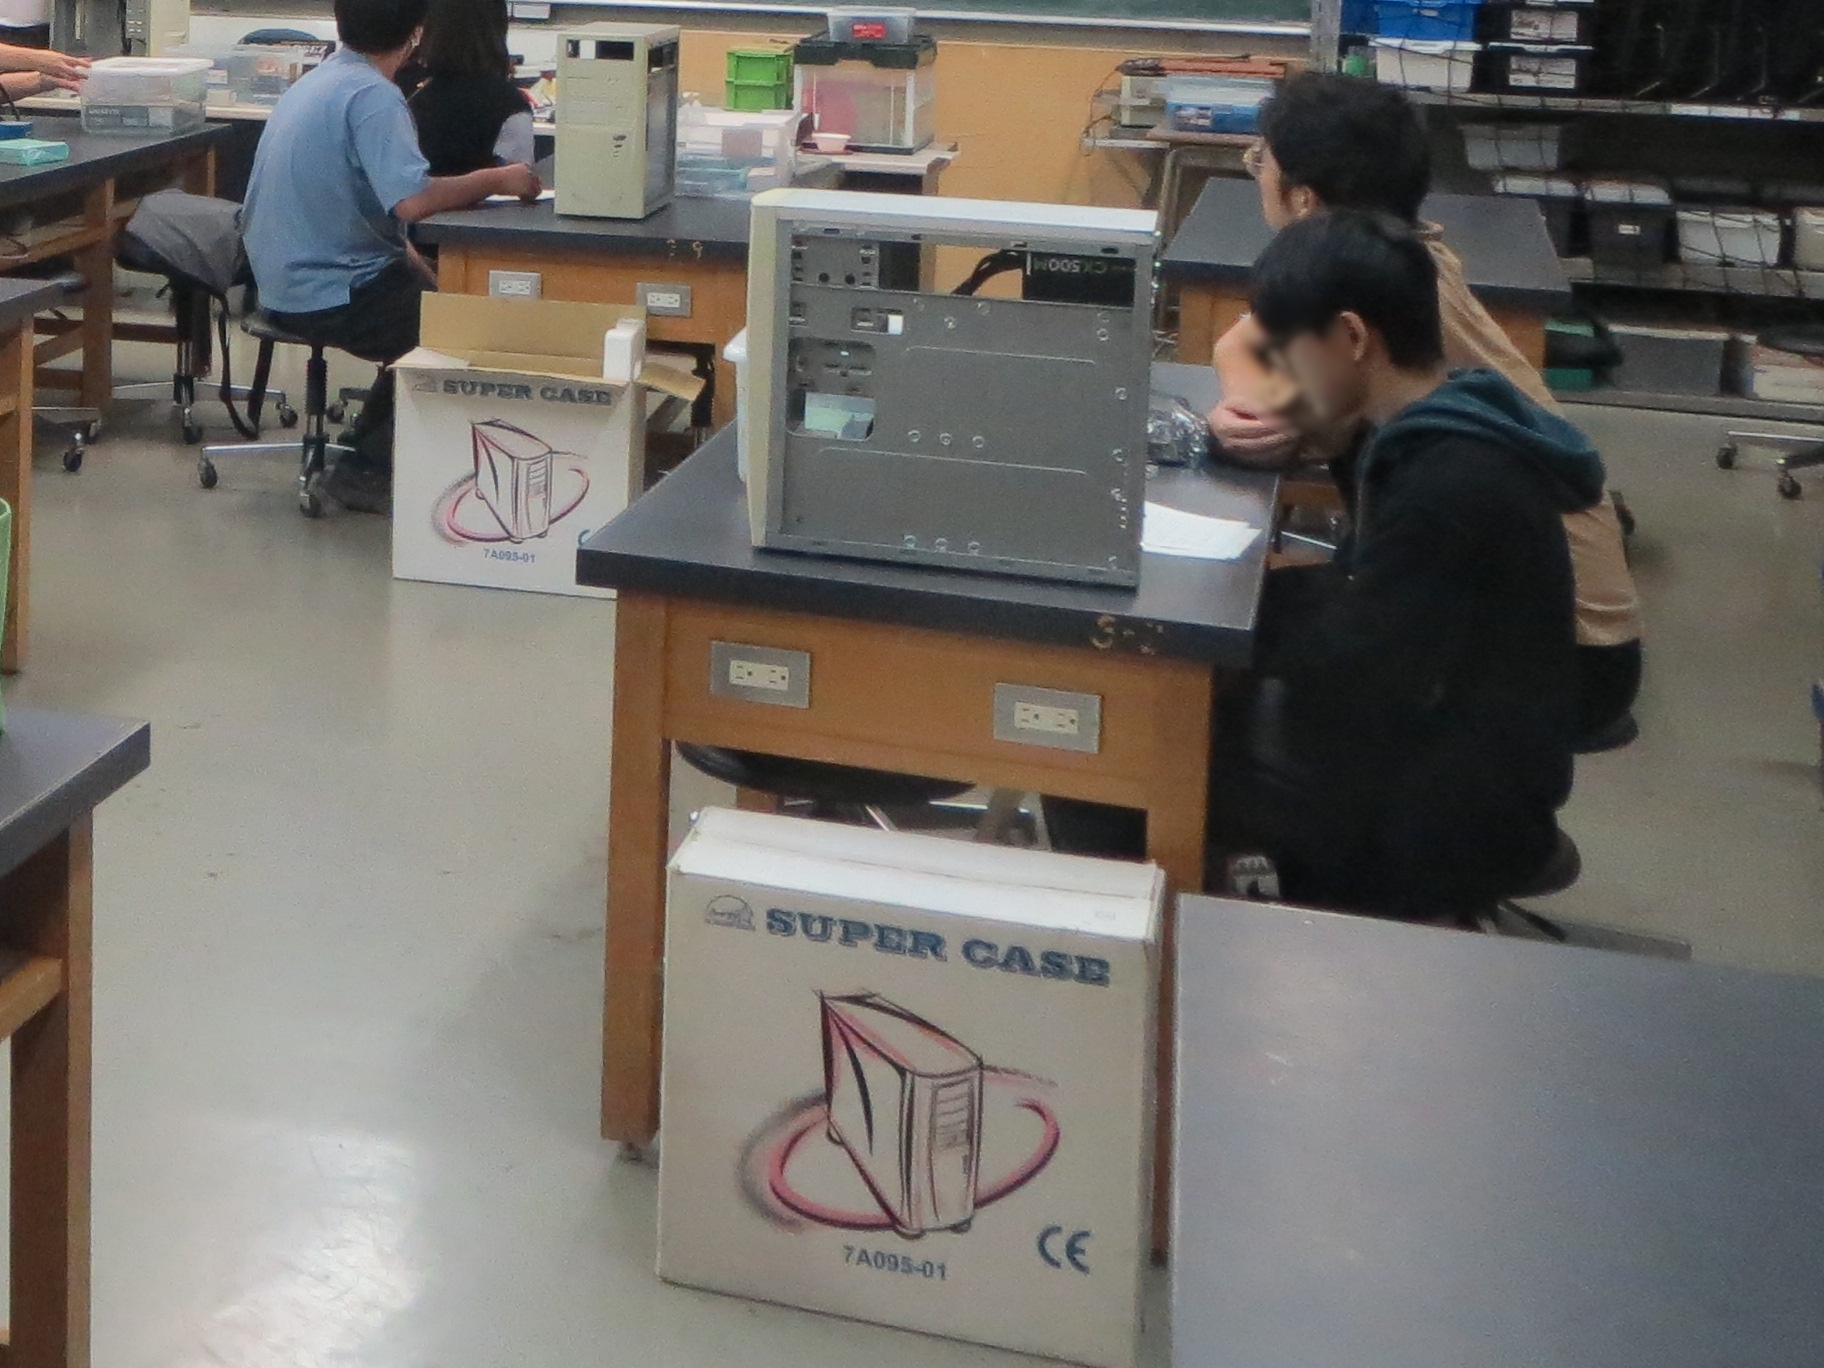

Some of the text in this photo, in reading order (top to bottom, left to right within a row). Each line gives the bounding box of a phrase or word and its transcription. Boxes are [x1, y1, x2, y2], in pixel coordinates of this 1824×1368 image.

[442, 379, 612, 406] SUPER CASE
[765, 906, 1111, 988] SUPER CASE
[842, 1245, 949, 1281] 7A095-01
